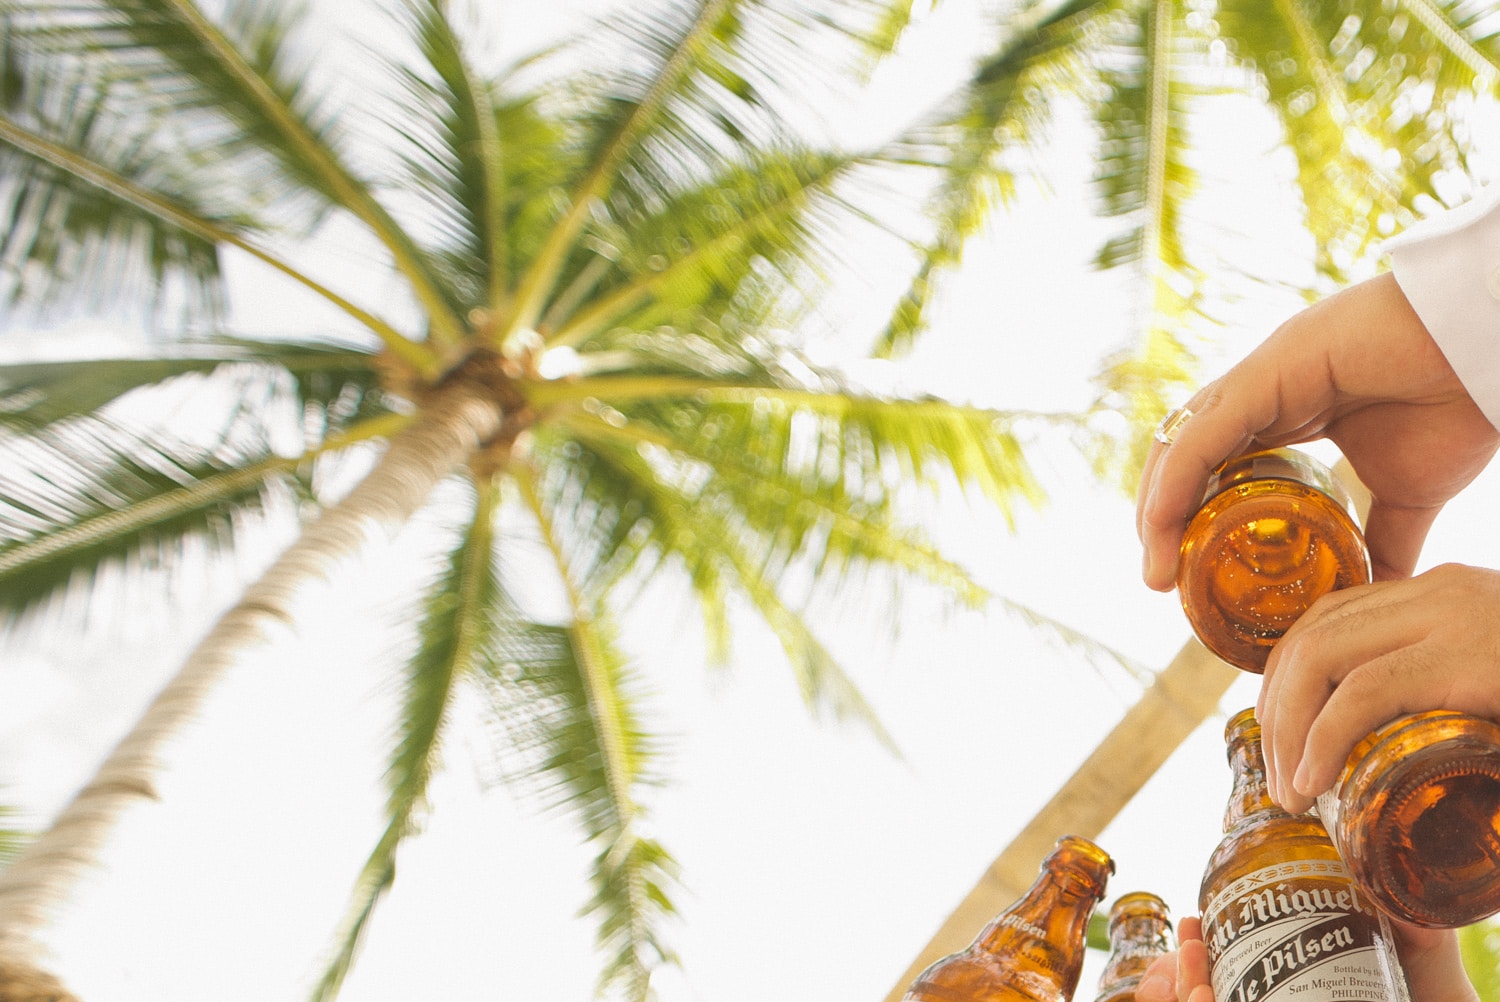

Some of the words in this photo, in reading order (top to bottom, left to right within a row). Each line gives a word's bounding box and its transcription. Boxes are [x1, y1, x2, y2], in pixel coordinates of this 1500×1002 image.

[1236, 883, 1363, 936] Miguel
[1254, 937, 1273, 950] Beer
[1261, 925, 1355, 992] Pilsen
[1333, 965, 1362, 975] Bottled
[1363, 967, 1372, 976] by
[1288, 984, 1309, 995] San
[1311, 976, 1347, 991] Miguel
